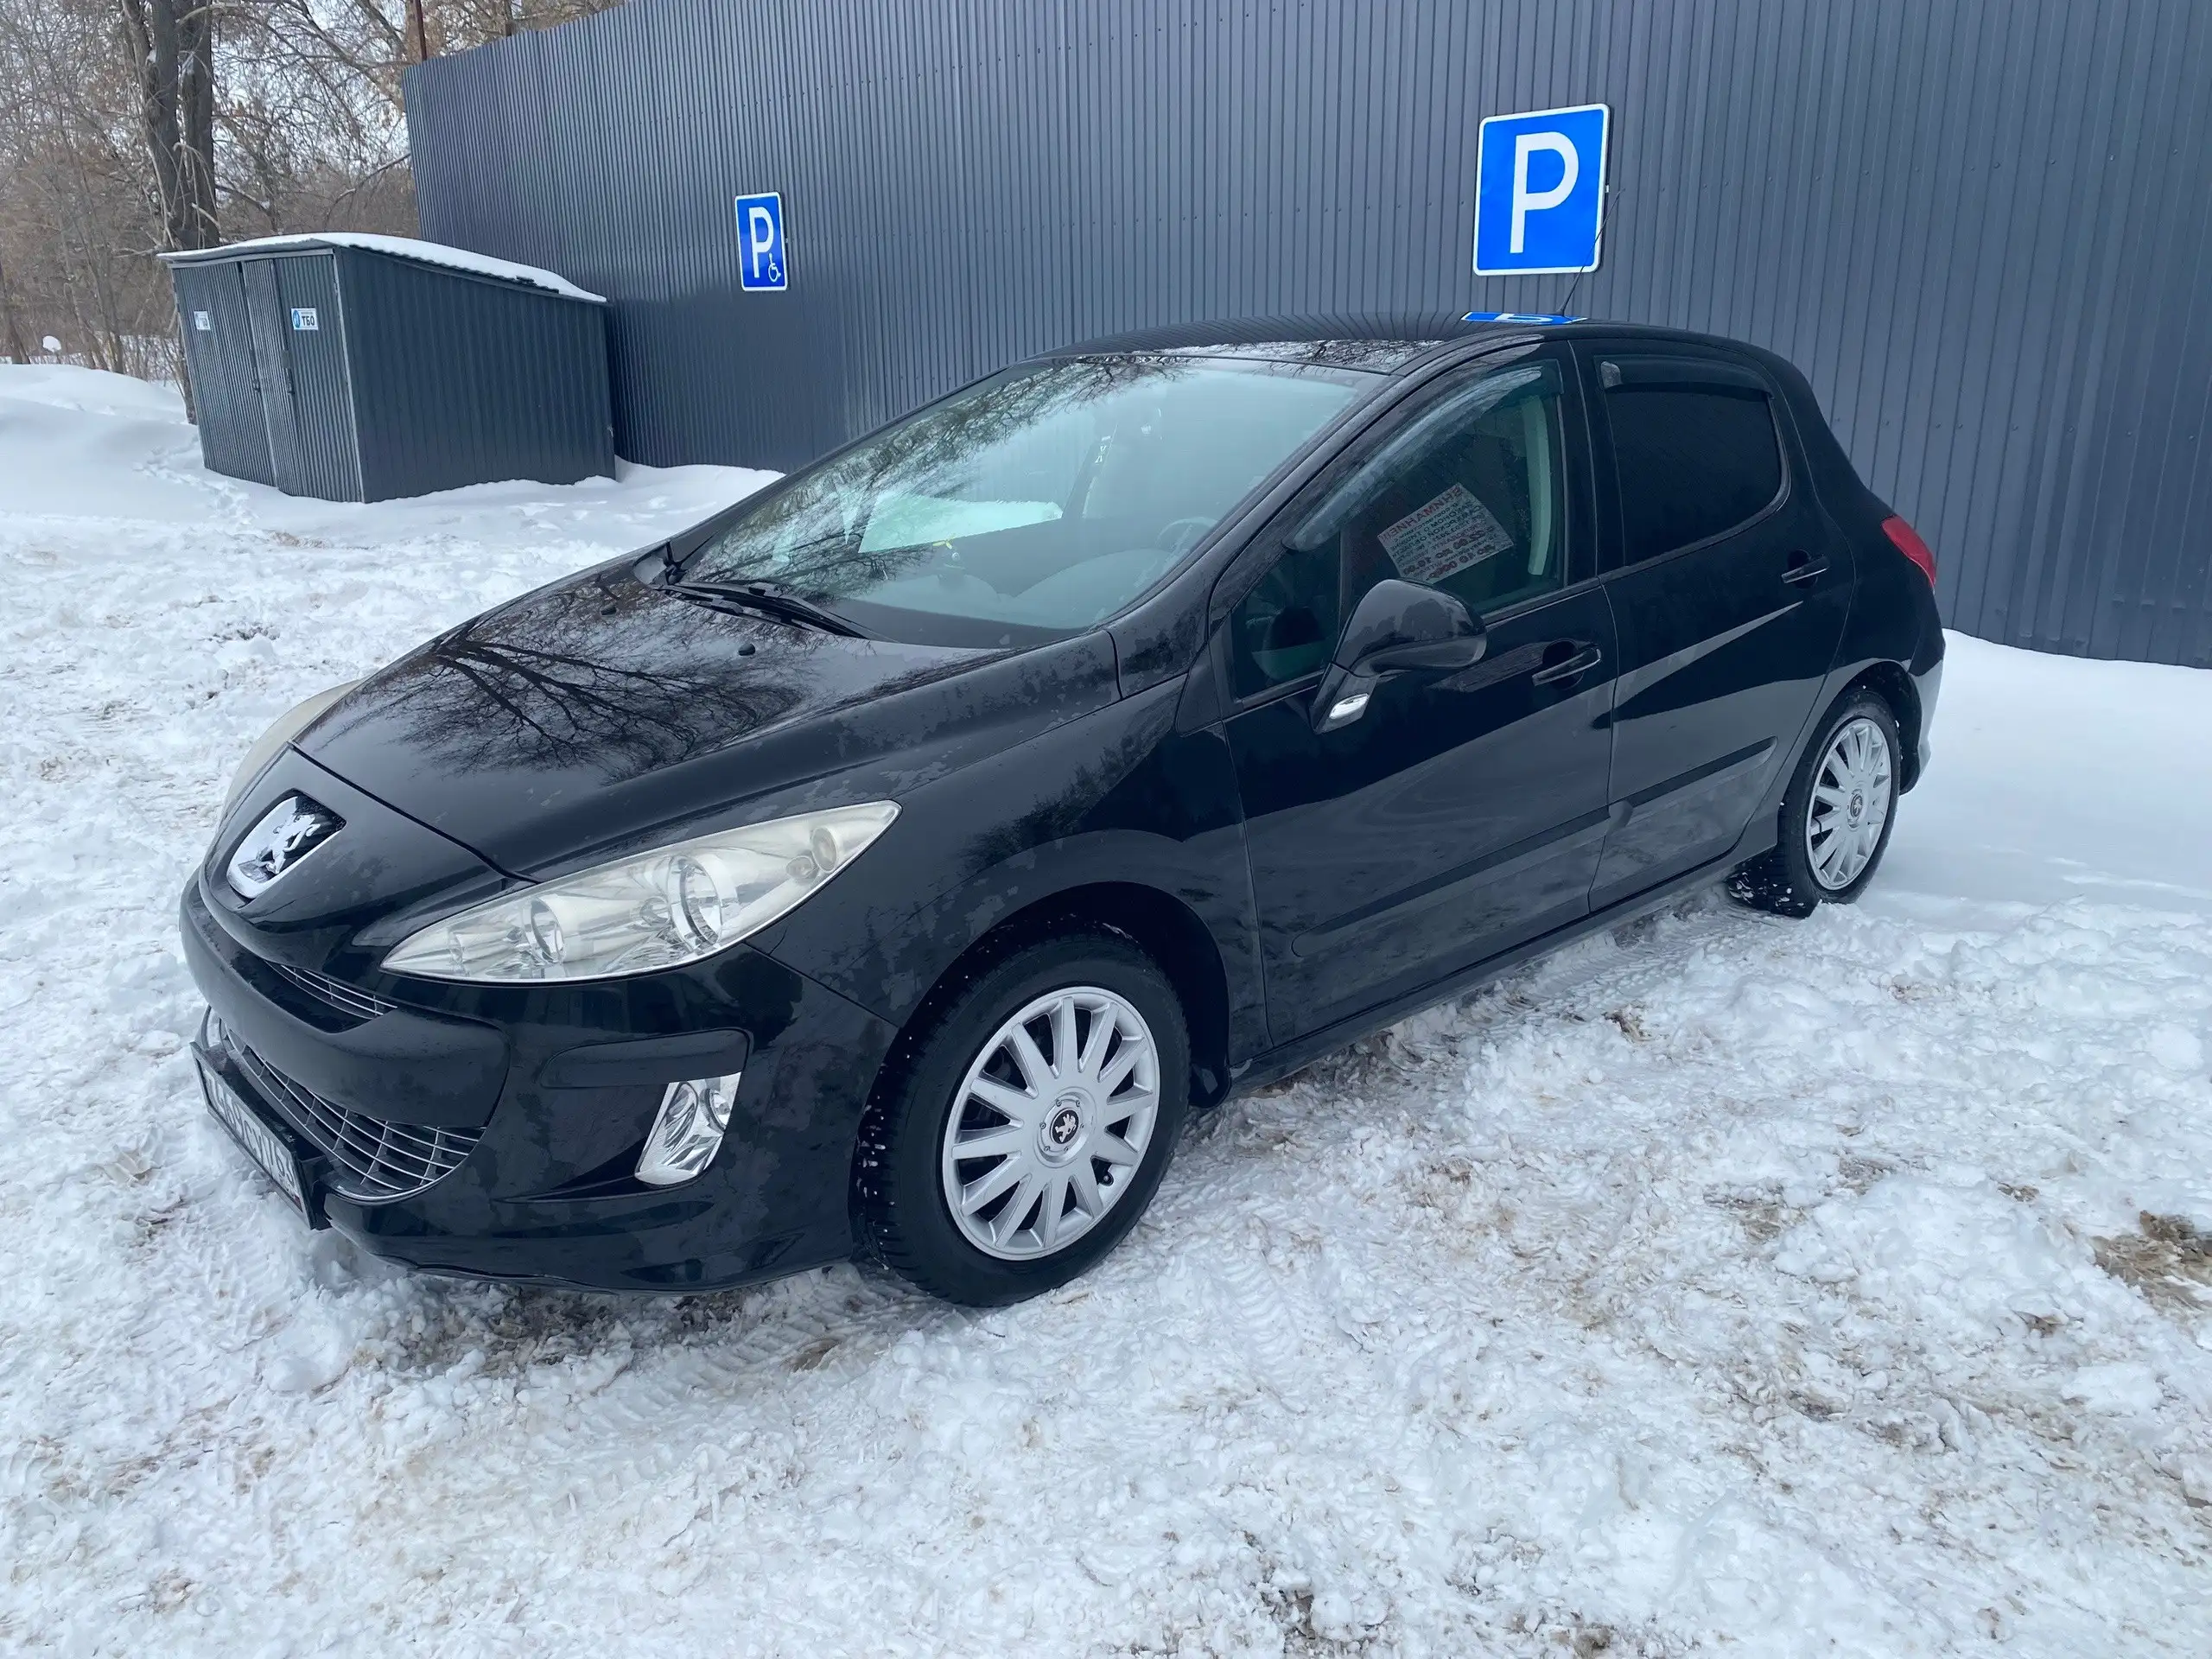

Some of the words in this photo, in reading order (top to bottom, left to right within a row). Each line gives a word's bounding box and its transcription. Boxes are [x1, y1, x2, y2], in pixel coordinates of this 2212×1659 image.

[1510, 131, 1580, 254] P
[748, 207, 774, 278] P
[301, 315, 315, 327] ТБО
